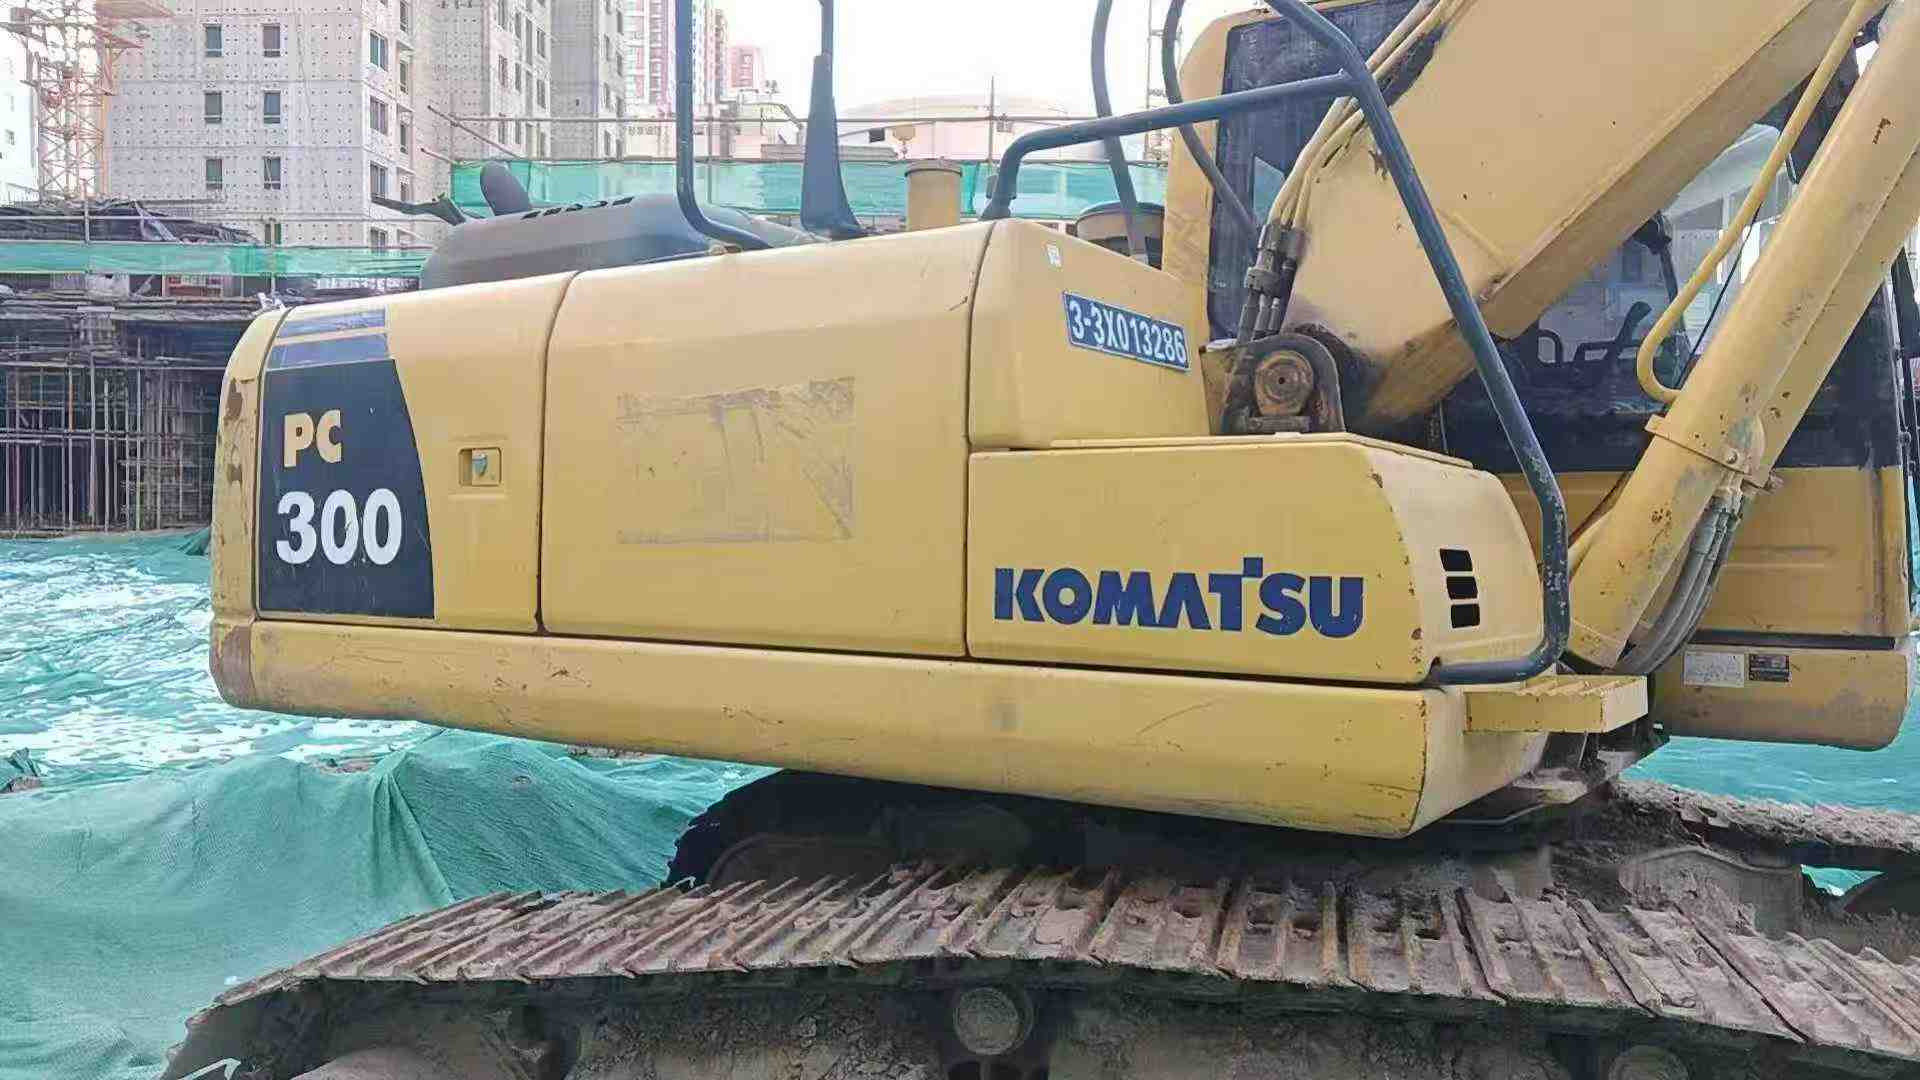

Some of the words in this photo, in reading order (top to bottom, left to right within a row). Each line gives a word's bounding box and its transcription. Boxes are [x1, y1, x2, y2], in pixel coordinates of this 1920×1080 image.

[1069, 300, 1186, 363] 3-3X013286
[284, 409, 342, 468] PC
[276, 488, 402, 565] 300
[994, 557, 1364, 638] KOMATSU
